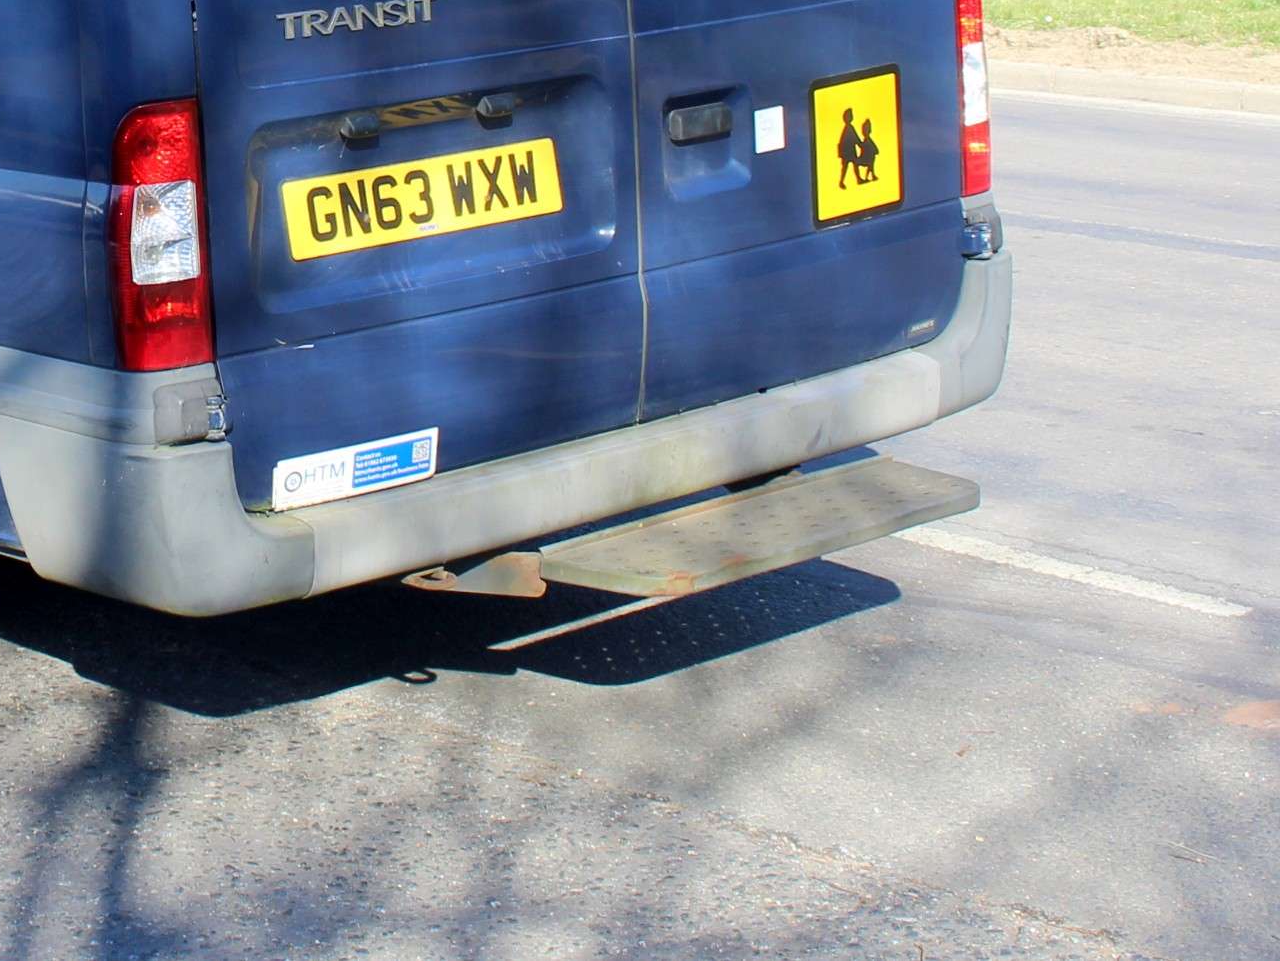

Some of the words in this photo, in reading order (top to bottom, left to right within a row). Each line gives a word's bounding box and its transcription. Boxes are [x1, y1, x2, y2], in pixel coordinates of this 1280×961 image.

[306, 170, 434, 242] GN63
[447, 151, 538, 217] WXW
[304, 461, 345, 485] HTM
